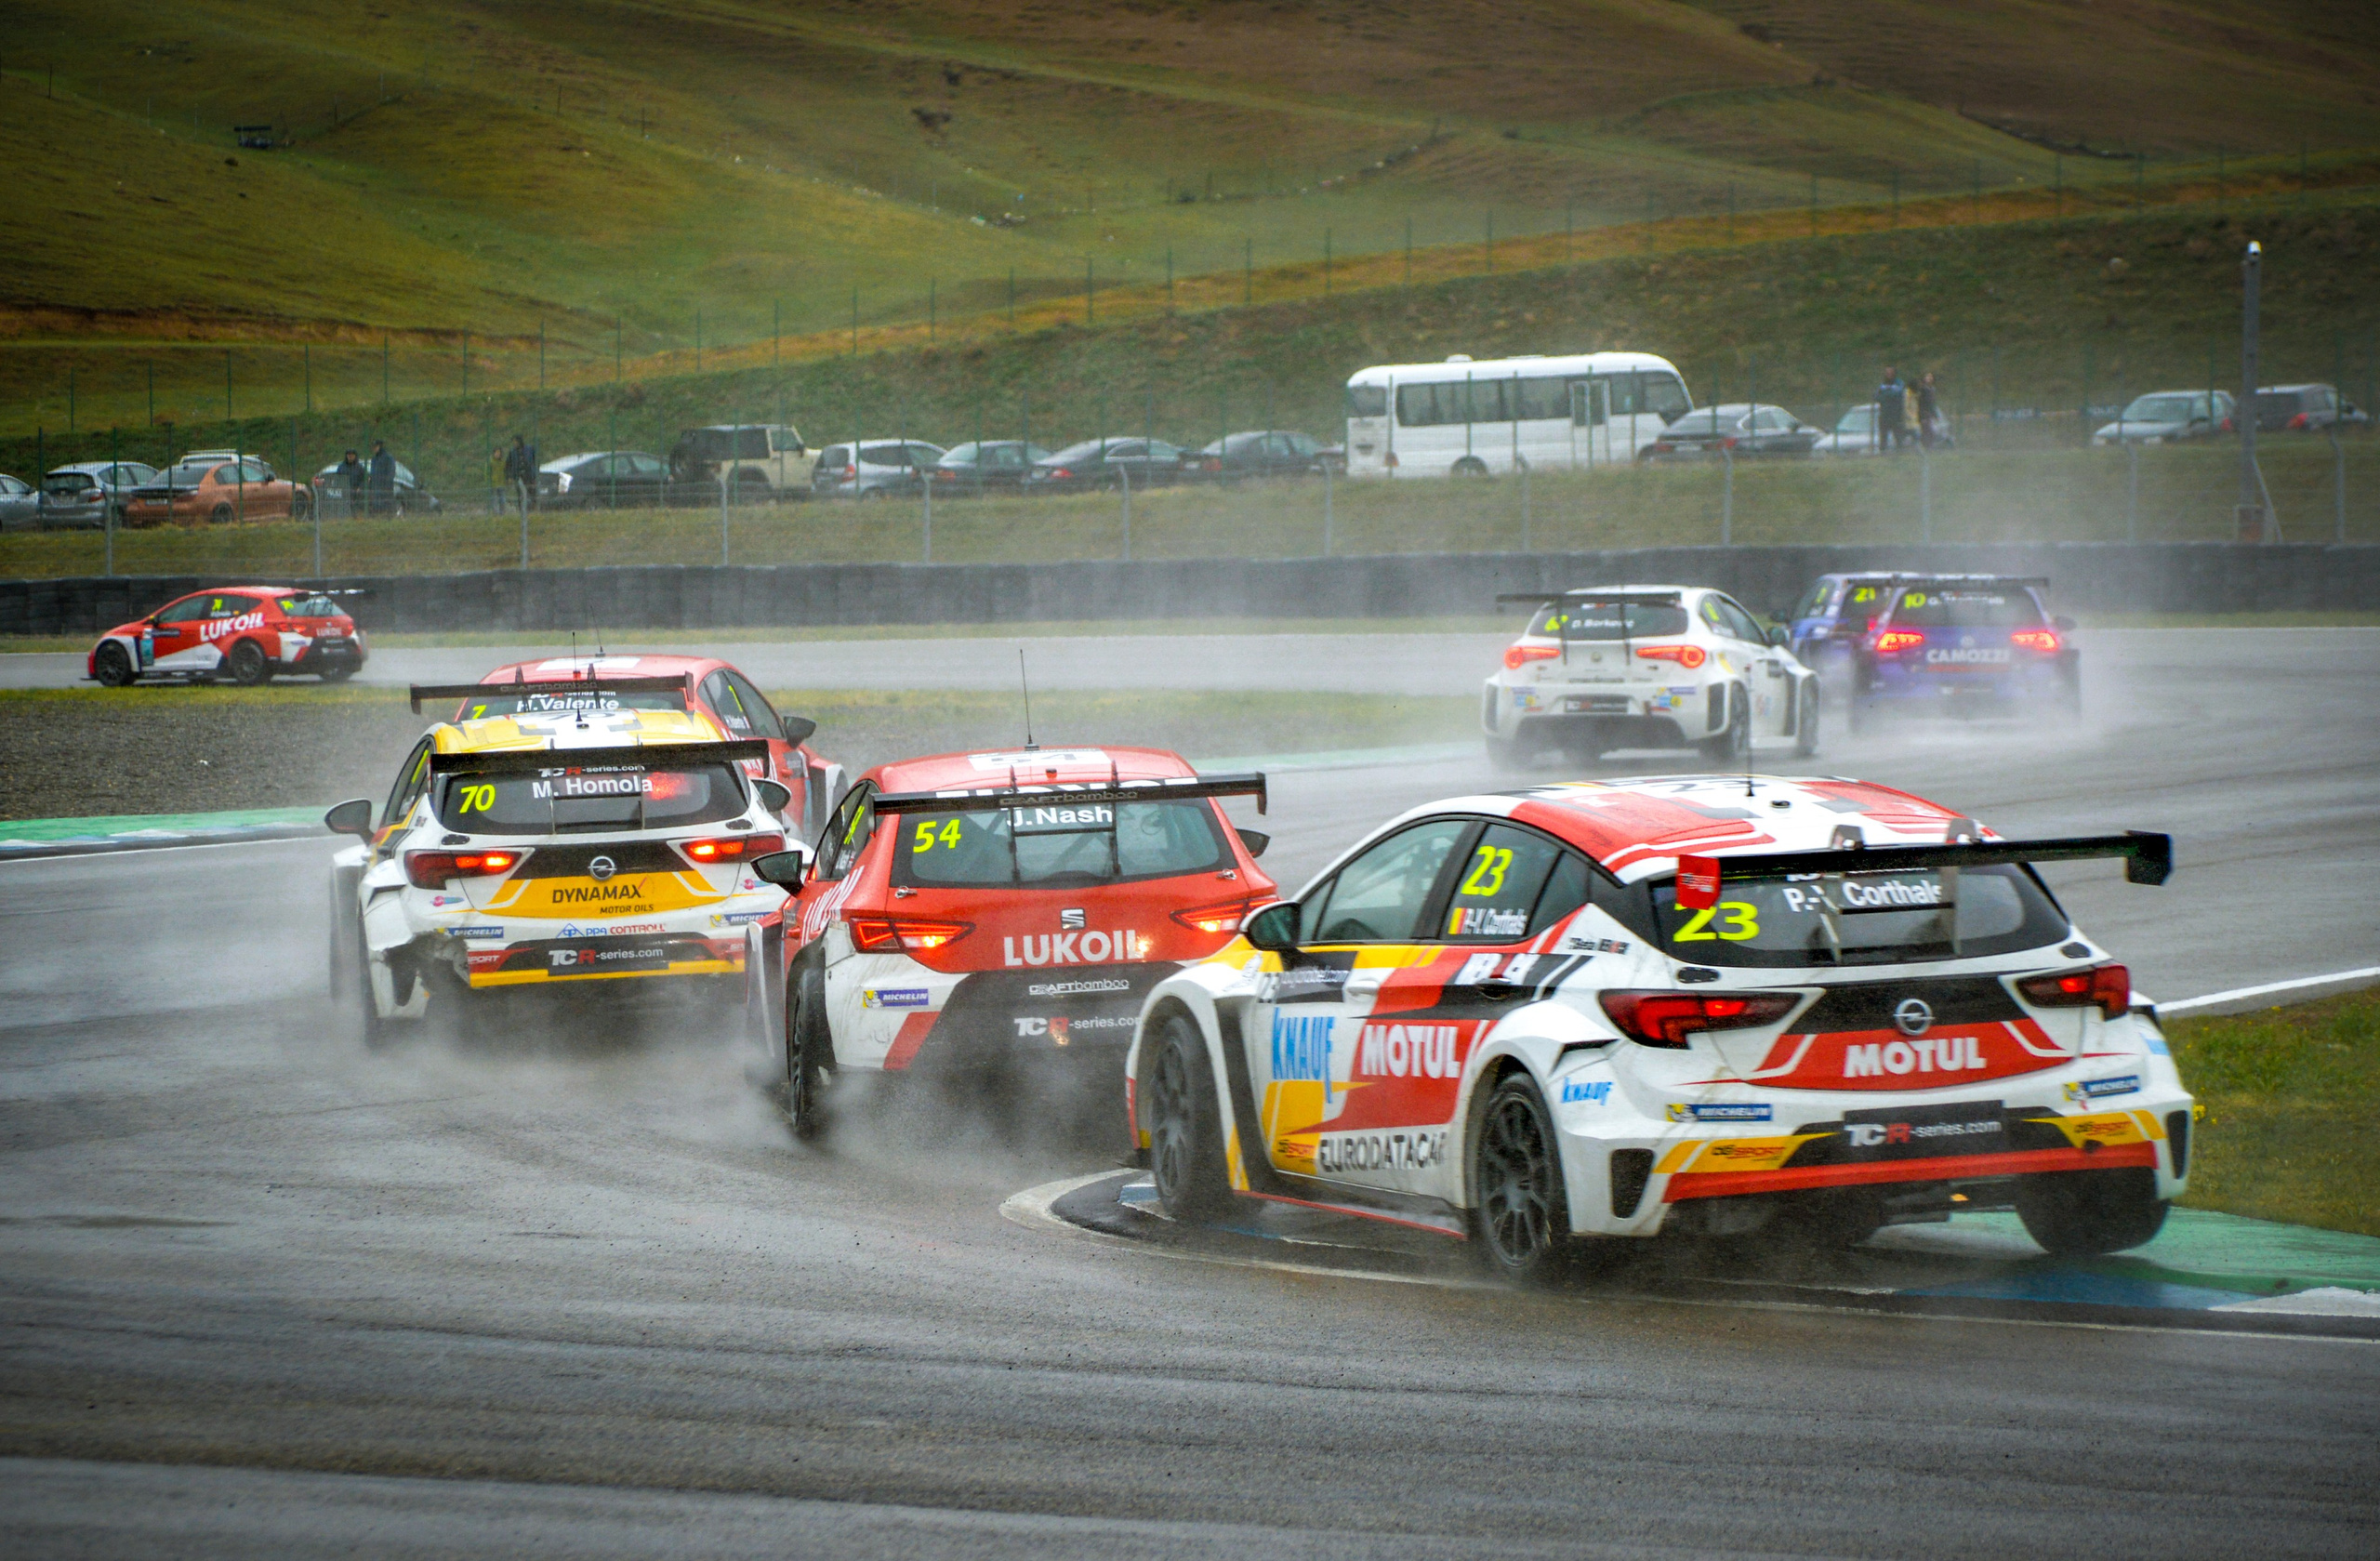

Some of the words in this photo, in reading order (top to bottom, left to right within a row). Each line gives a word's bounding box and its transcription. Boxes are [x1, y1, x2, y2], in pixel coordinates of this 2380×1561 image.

[1905, 592, 1926, 609] 10
[200, 612, 264, 642] LUKOIL
[459, 784, 496, 814] 70
[533, 781, 558, 799] M.
[565, 775, 653, 796] Homola
[1006, 807, 1113, 827] J.Nash
[913, 818, 961, 853] 54
[1461, 845, 1514, 897] 23
[552, 878, 647, 904] DYNAMAX
[1843, 880, 1942, 906] Corthals
[600, 906, 631, 915] MOTOR
[634, 904, 654, 913] OILS
[1673, 902, 1760, 943] 23
[549, 948, 663, 966] TCR-series.com
[1004, 930, 1144, 967] LUKOIL
[882, 993, 928, 1001] MICHELIN
[1029, 979, 1130, 995] CRAFTbamboo
[1360, 1025, 1461, 1078] MOTUL
[1843, 1037, 1987, 1078] MOTUL
[1844, 1120, 2002, 1146] TCR-series.com
